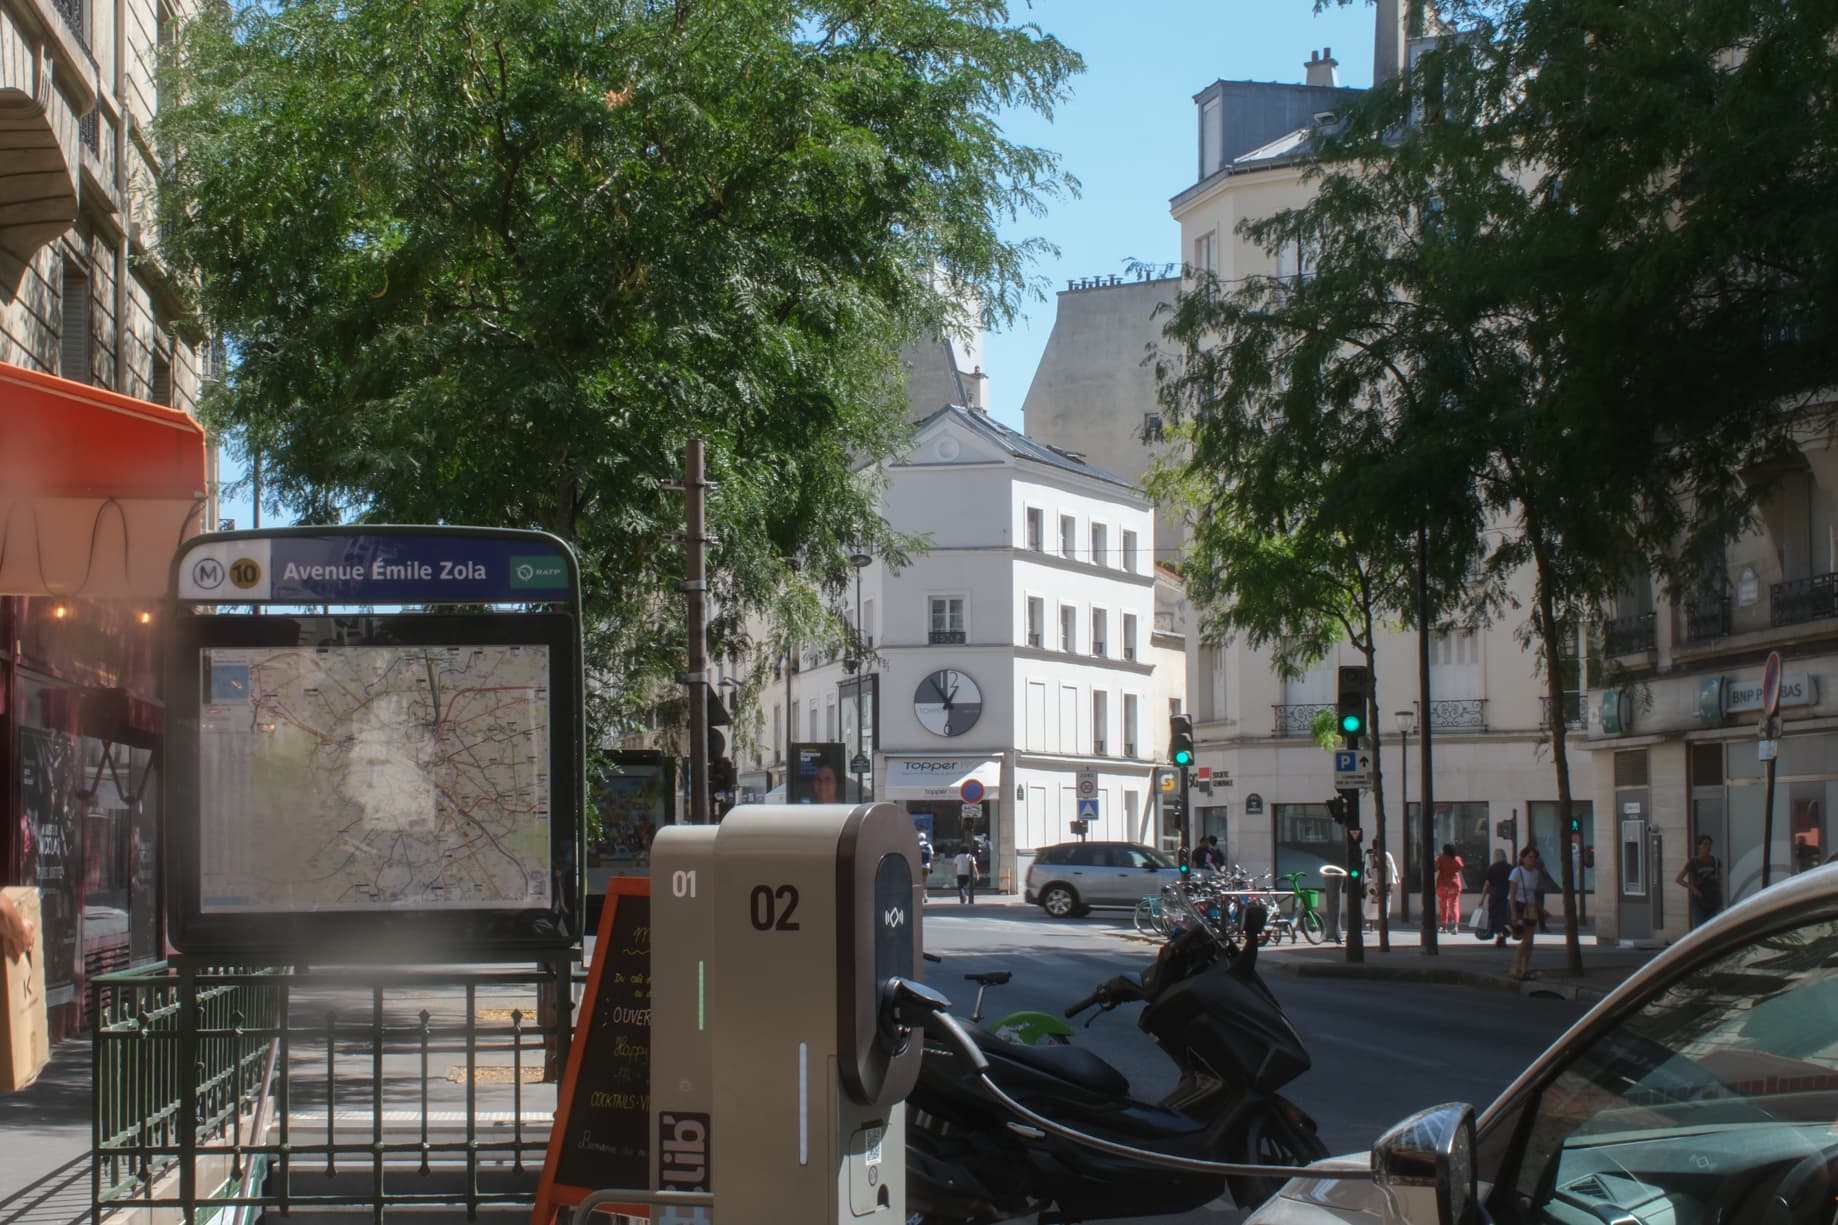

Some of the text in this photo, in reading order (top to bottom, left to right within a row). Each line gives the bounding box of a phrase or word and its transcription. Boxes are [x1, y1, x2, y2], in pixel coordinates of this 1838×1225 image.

[232, 564, 257, 583] 10
[283, 562, 364, 580] Avenue
[371, 557, 433, 580] Émile
[439, 561, 487, 580] Zola
[535, 568, 561, 576] RATP
[1732, 690, 1754, 704] BNP
[1340, 755, 1351, 769] P
[672, 870, 697, 898] 01
[750, 884, 800, 931] 02
